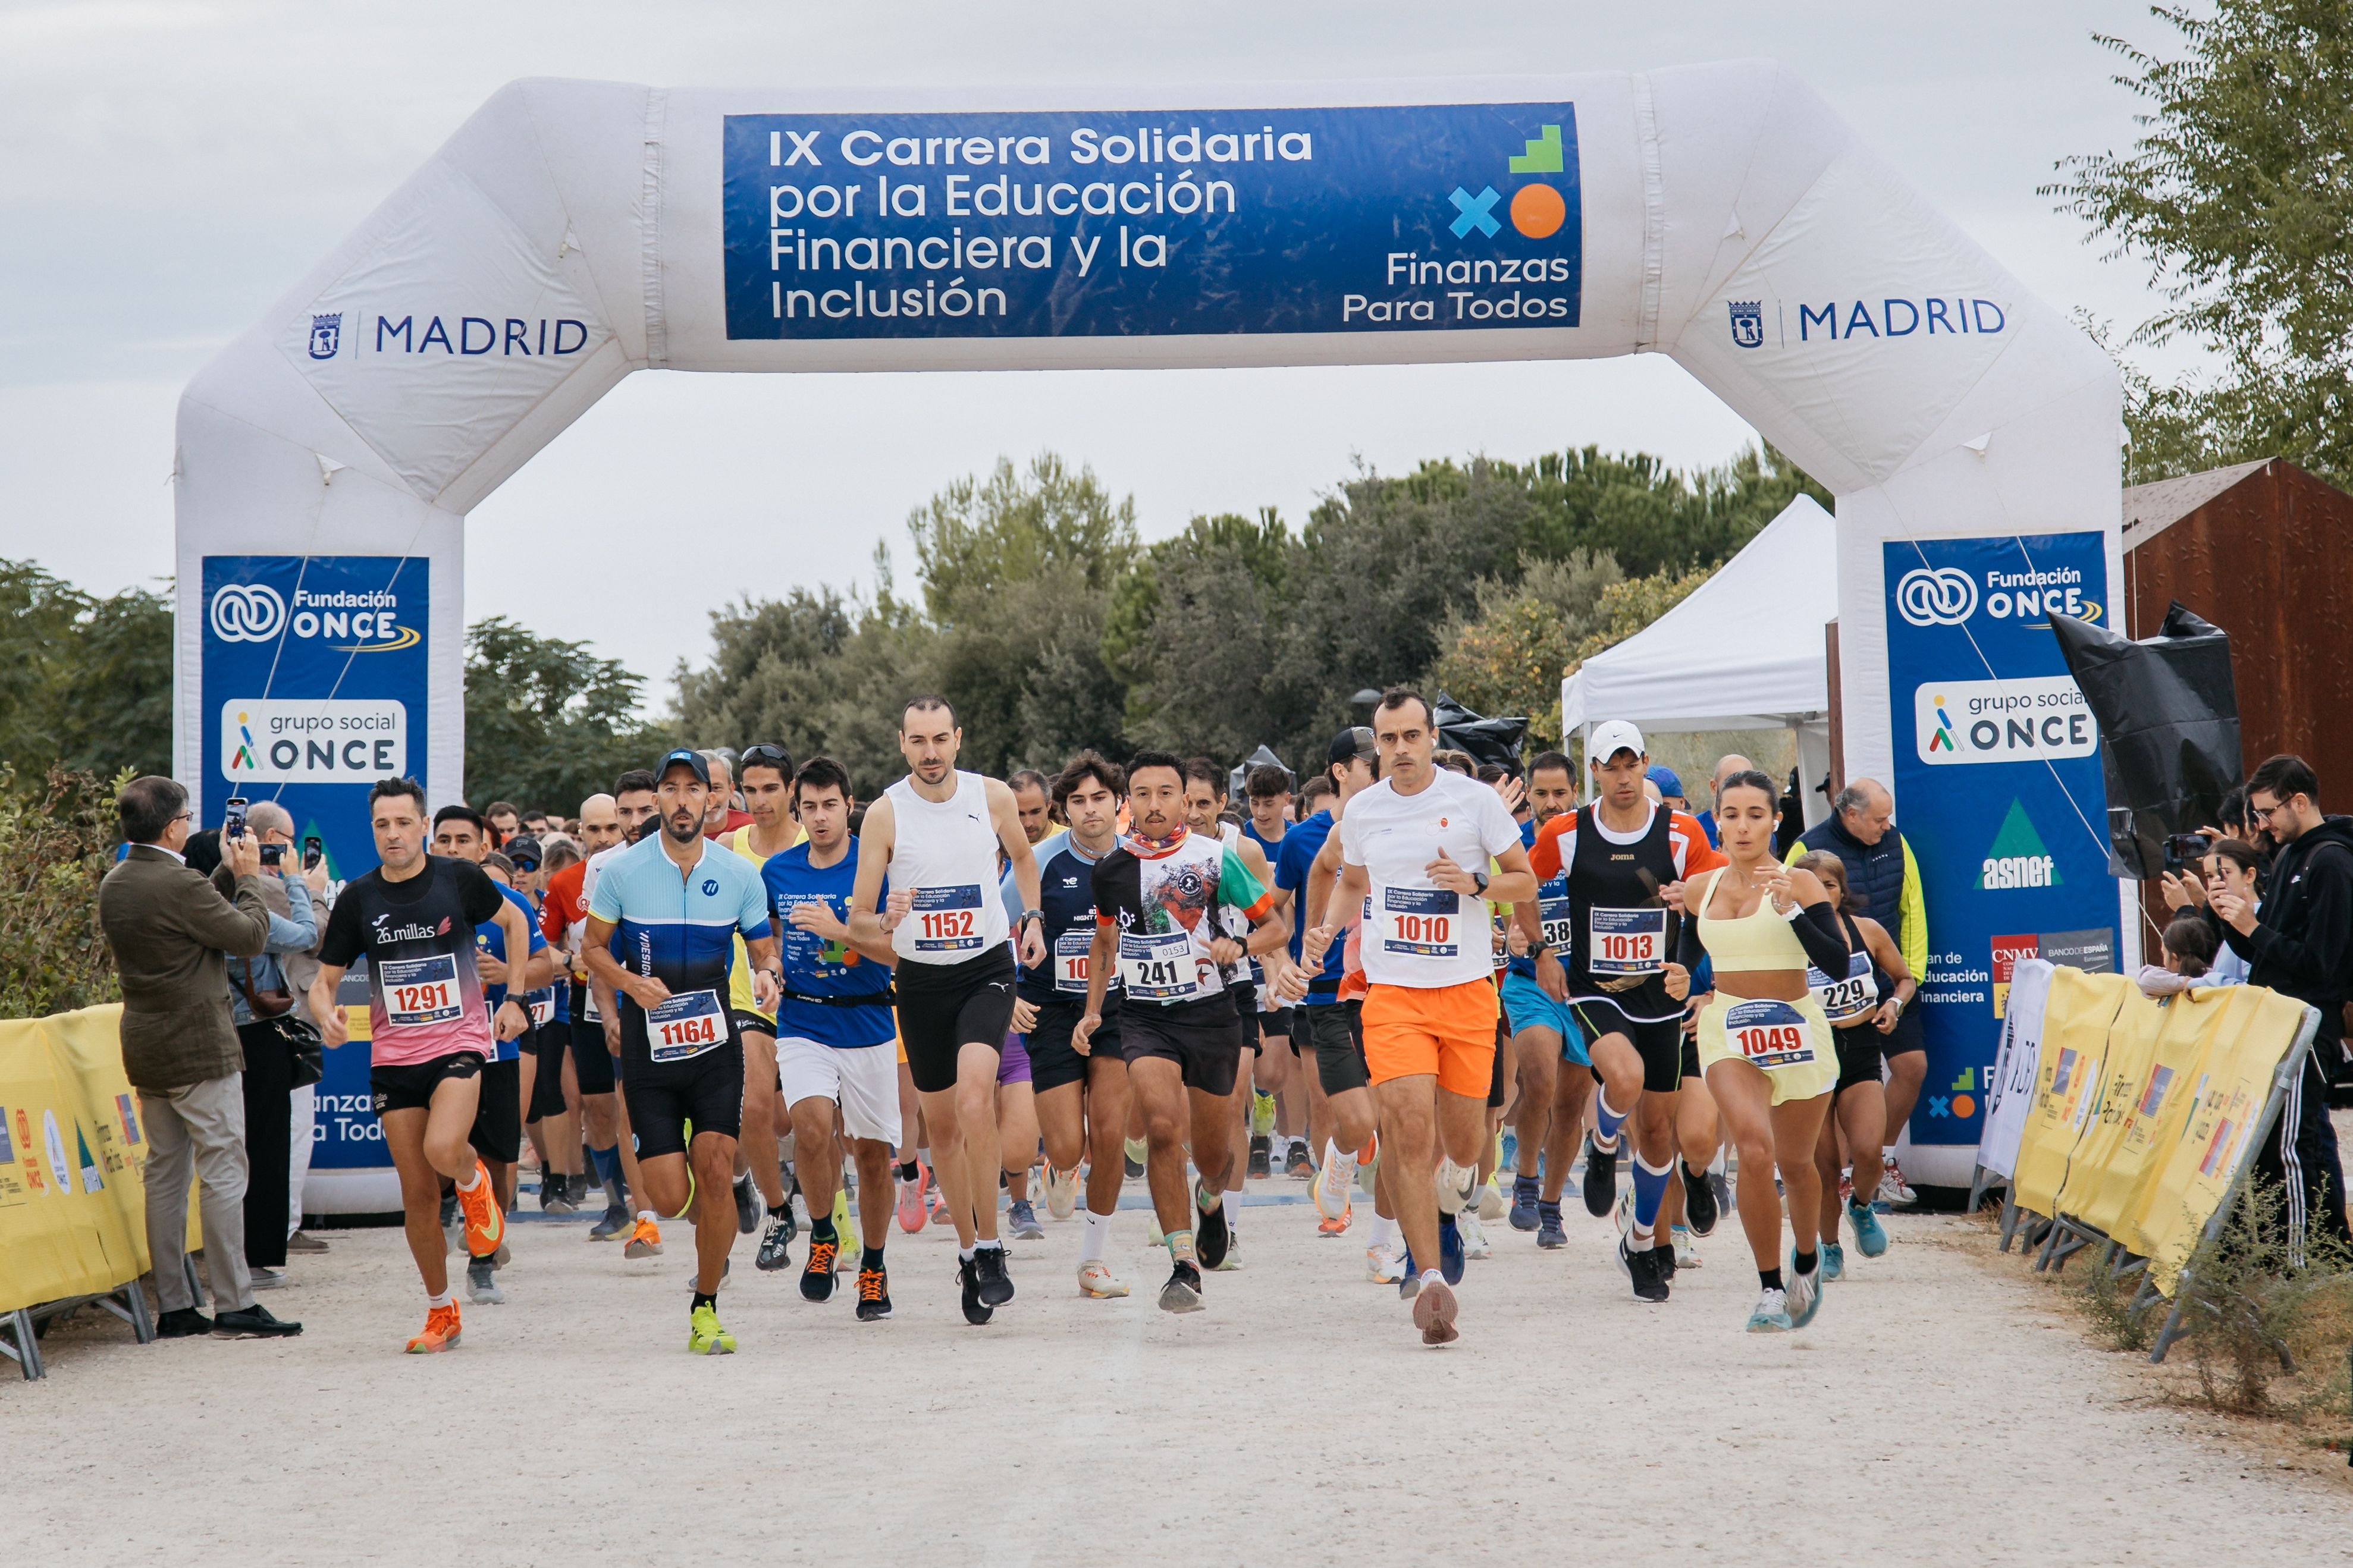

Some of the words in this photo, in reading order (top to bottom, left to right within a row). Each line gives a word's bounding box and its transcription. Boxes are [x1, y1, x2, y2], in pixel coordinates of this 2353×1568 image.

[770, 129, 821, 166] IX
[840, 129, 1050, 166] Carrera
[1070, 127, 1312, 163] Solidaria
[770, 185, 858, 228] por
[878, 178, 927, 216] la
[945, 171, 1236, 218] Educación
[770, 228, 1053, 271] Financiera
[1069, 240, 1102, 276] y
[1120, 227, 1167, 267] la
[1386, 252, 1569, 286] Finanzas
[773, 278, 1007, 318] Inclusión
[1343, 294, 1435, 322] Para
[1448, 290, 1568, 319] Todos
[1800, 298, 2006, 341] MADRID
[377, 316, 587, 356] MADRID
[1987, 567, 2081, 588] Fundación
[294, 590, 397, 608] Fundación
[1987, 588, 2082, 618] ONCE
[293, 612, 397, 639] ONCE
[1969, 695, 2031, 715] grupo
[2038, 688, 2087, 706] socia
[270, 717, 334, 733] grupo
[339, 713, 396, 730] social
[1970, 714, 2088, 750] ONCE
[271, 739, 395, 770] ONCE
[1982, 854, 2054, 890] asnef
[376, 926, 391, 944] 26
[394, 923, 435, 941] millas
[921, 911, 974, 938] 1152
[1394, 915, 1449, 943] 1010
[641, 942, 651, 978] DESIGN
[1162, 945, 1184, 956] 0153
[1601, 935, 1652, 960] 1013
[1927, 954, 1941, 964] an
[1946, 952, 1962, 964] de
[1992, 948, 2038, 963] CNMV
[2084, 943, 2108, 954] ESPAÑA
[1066, 958, 1116, 979] 10
[1137, 960, 1178, 985] 241
[1925, 969, 1988, 982] ducación
[394, 983, 448, 1011] 1291
[1824, 979, 1864, 1007] 229
[1920, 990, 1984, 1003] inanciera
[660, 1017, 716, 1045] 1164
[1736, 1027, 1802, 1056] 1049
